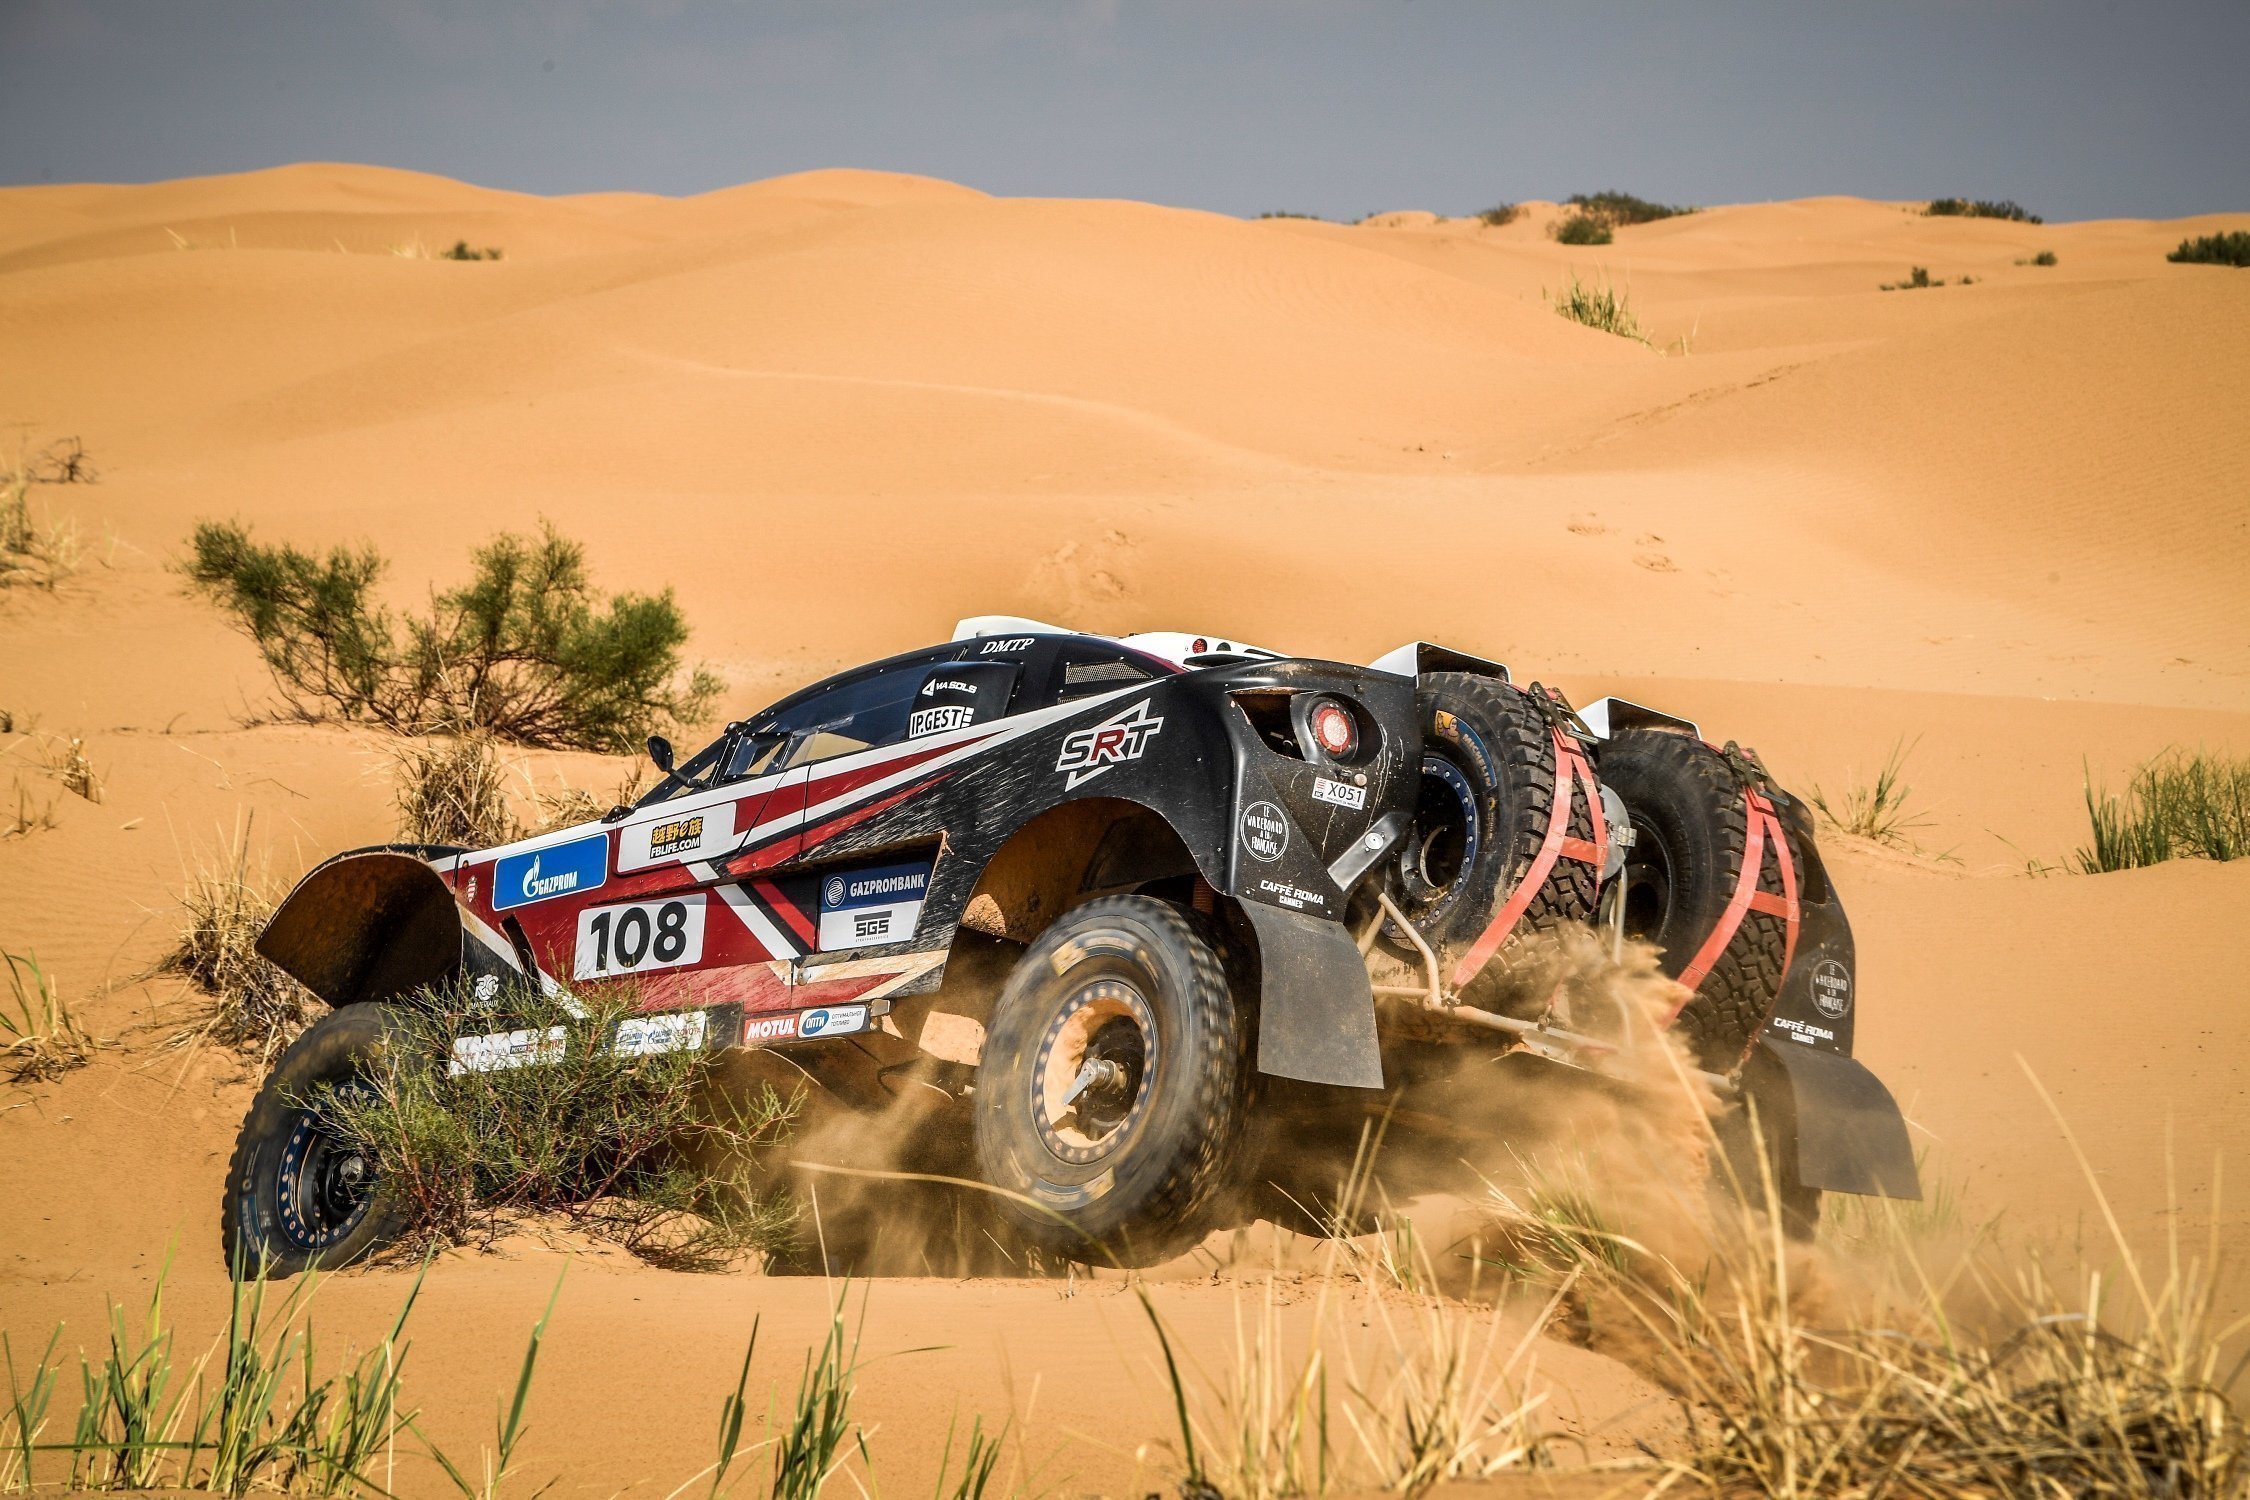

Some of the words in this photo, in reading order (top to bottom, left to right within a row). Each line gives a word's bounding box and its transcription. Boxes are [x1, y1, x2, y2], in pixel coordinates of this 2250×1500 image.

[980, 638, 1035, 654] DMTP
[911, 708, 962, 735] IP.GEST
[1056, 717, 1164, 772] SRT
[1463, 733, 1492, 787] MICHELIN
[1328, 782, 1362, 803] X051
[650, 837, 700, 858] FBLIFE.COM
[538, 871, 577, 896] GAZPROM
[850, 873, 925, 898] GAZPROMBANK
[1294, 888, 1324, 905] ROMA
[590, 901, 688, 972] 108
[855, 919, 889, 938] SGS
[746, 1018, 796, 1040] MOTUL
[1804, 1025, 1834, 1041] ROMA
